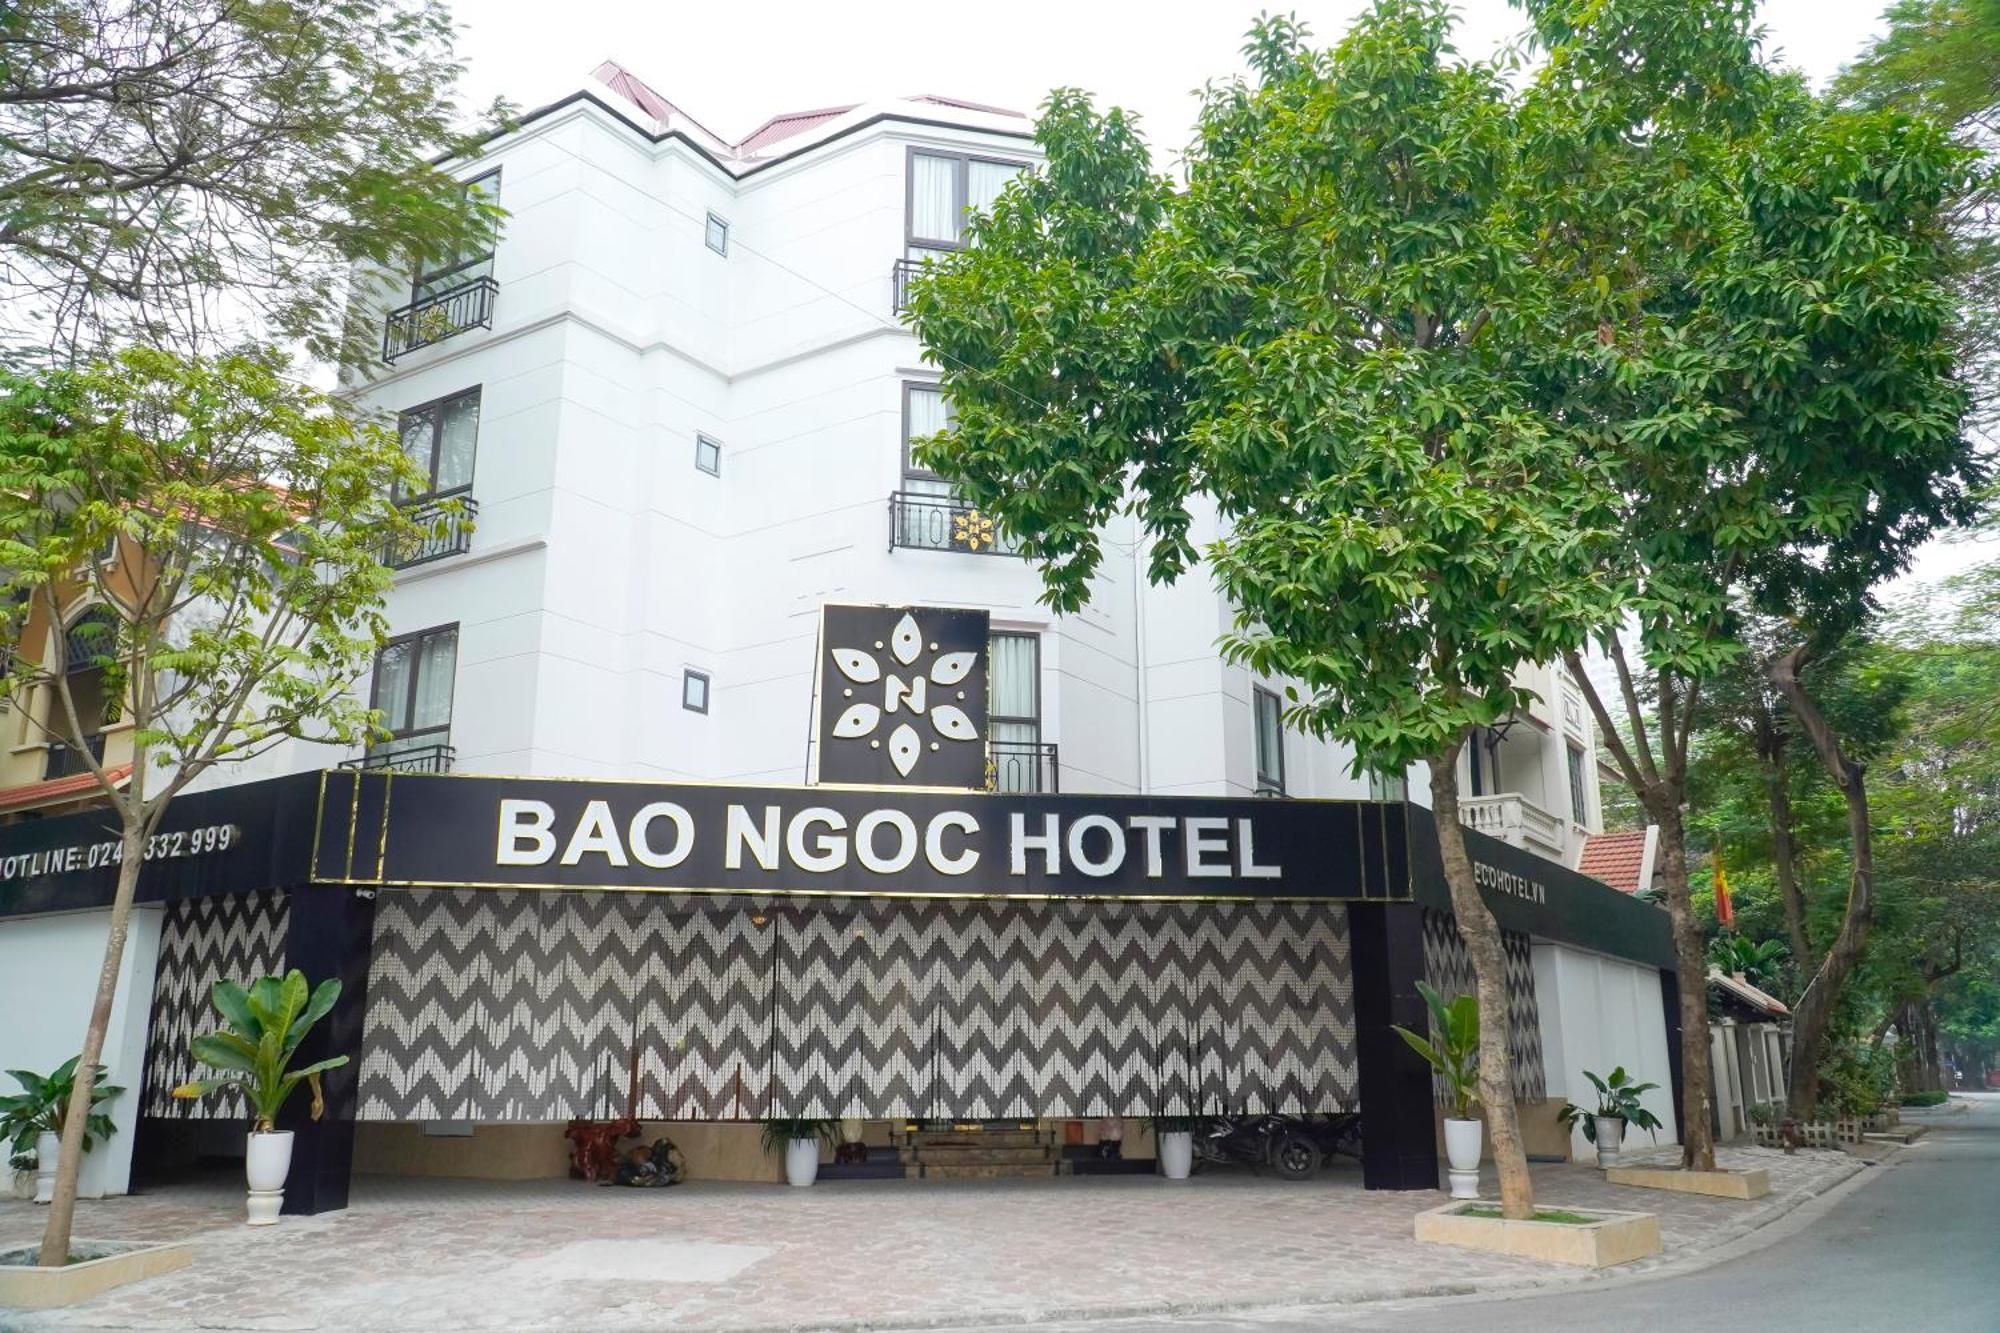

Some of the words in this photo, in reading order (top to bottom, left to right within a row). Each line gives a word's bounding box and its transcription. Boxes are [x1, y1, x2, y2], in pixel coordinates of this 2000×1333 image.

[190, 824, 232, 855] 999
[495, 799, 696, 869] BAO
[724, 804, 980, 874] NGOC
[1009, 812, 1283, 879] HOTEL
